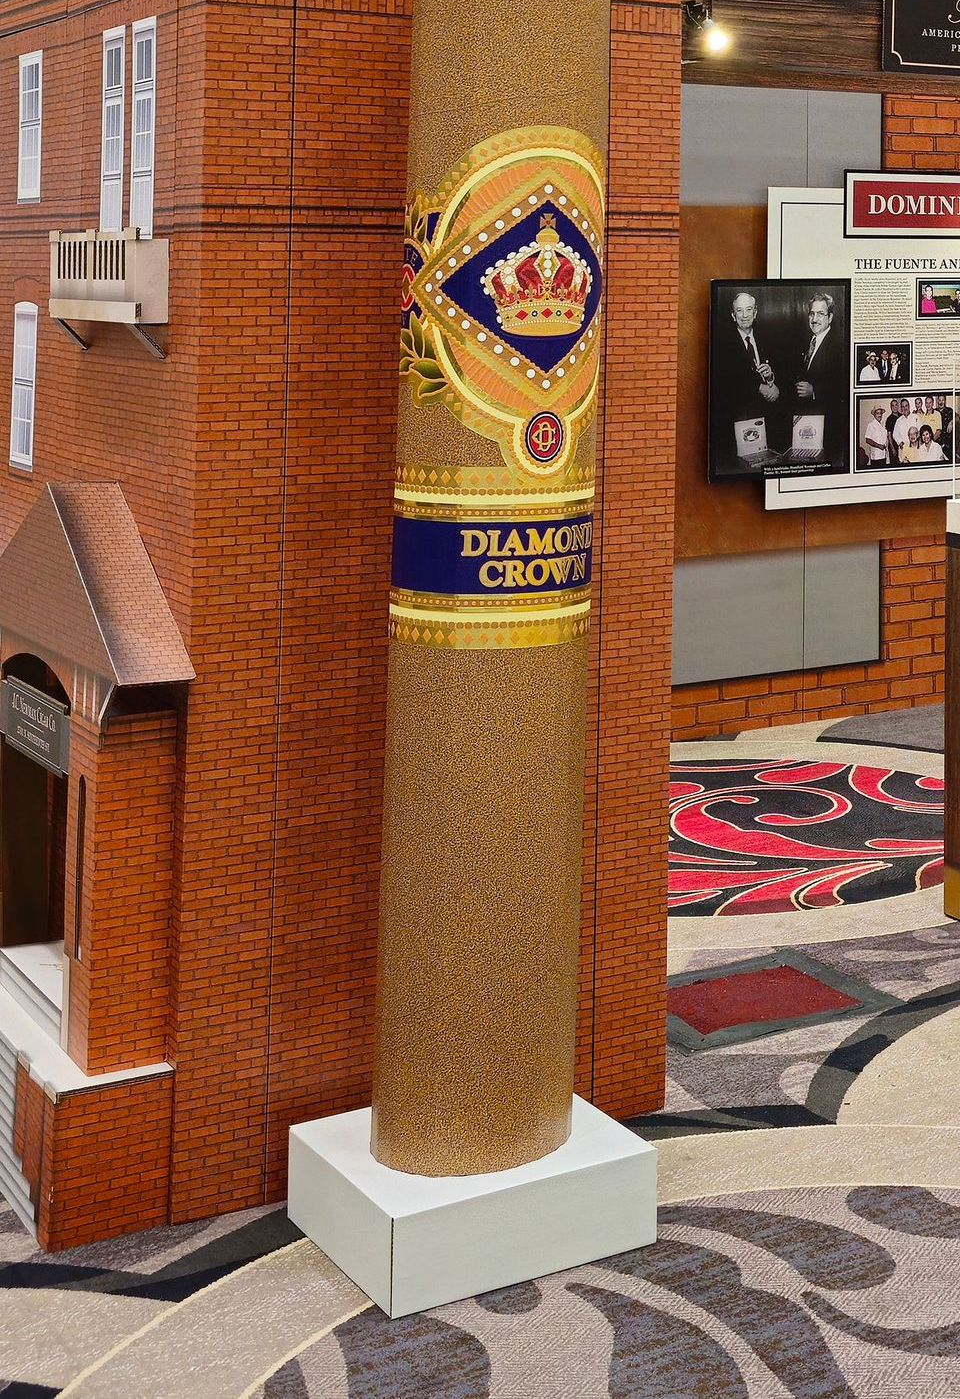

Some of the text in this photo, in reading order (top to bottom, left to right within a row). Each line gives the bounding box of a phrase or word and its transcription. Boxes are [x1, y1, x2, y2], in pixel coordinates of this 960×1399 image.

[854, 258, 882, 270] THE
[884, 258, 937, 270] FUENTE
[478, 552, 587, 588] CROWN
